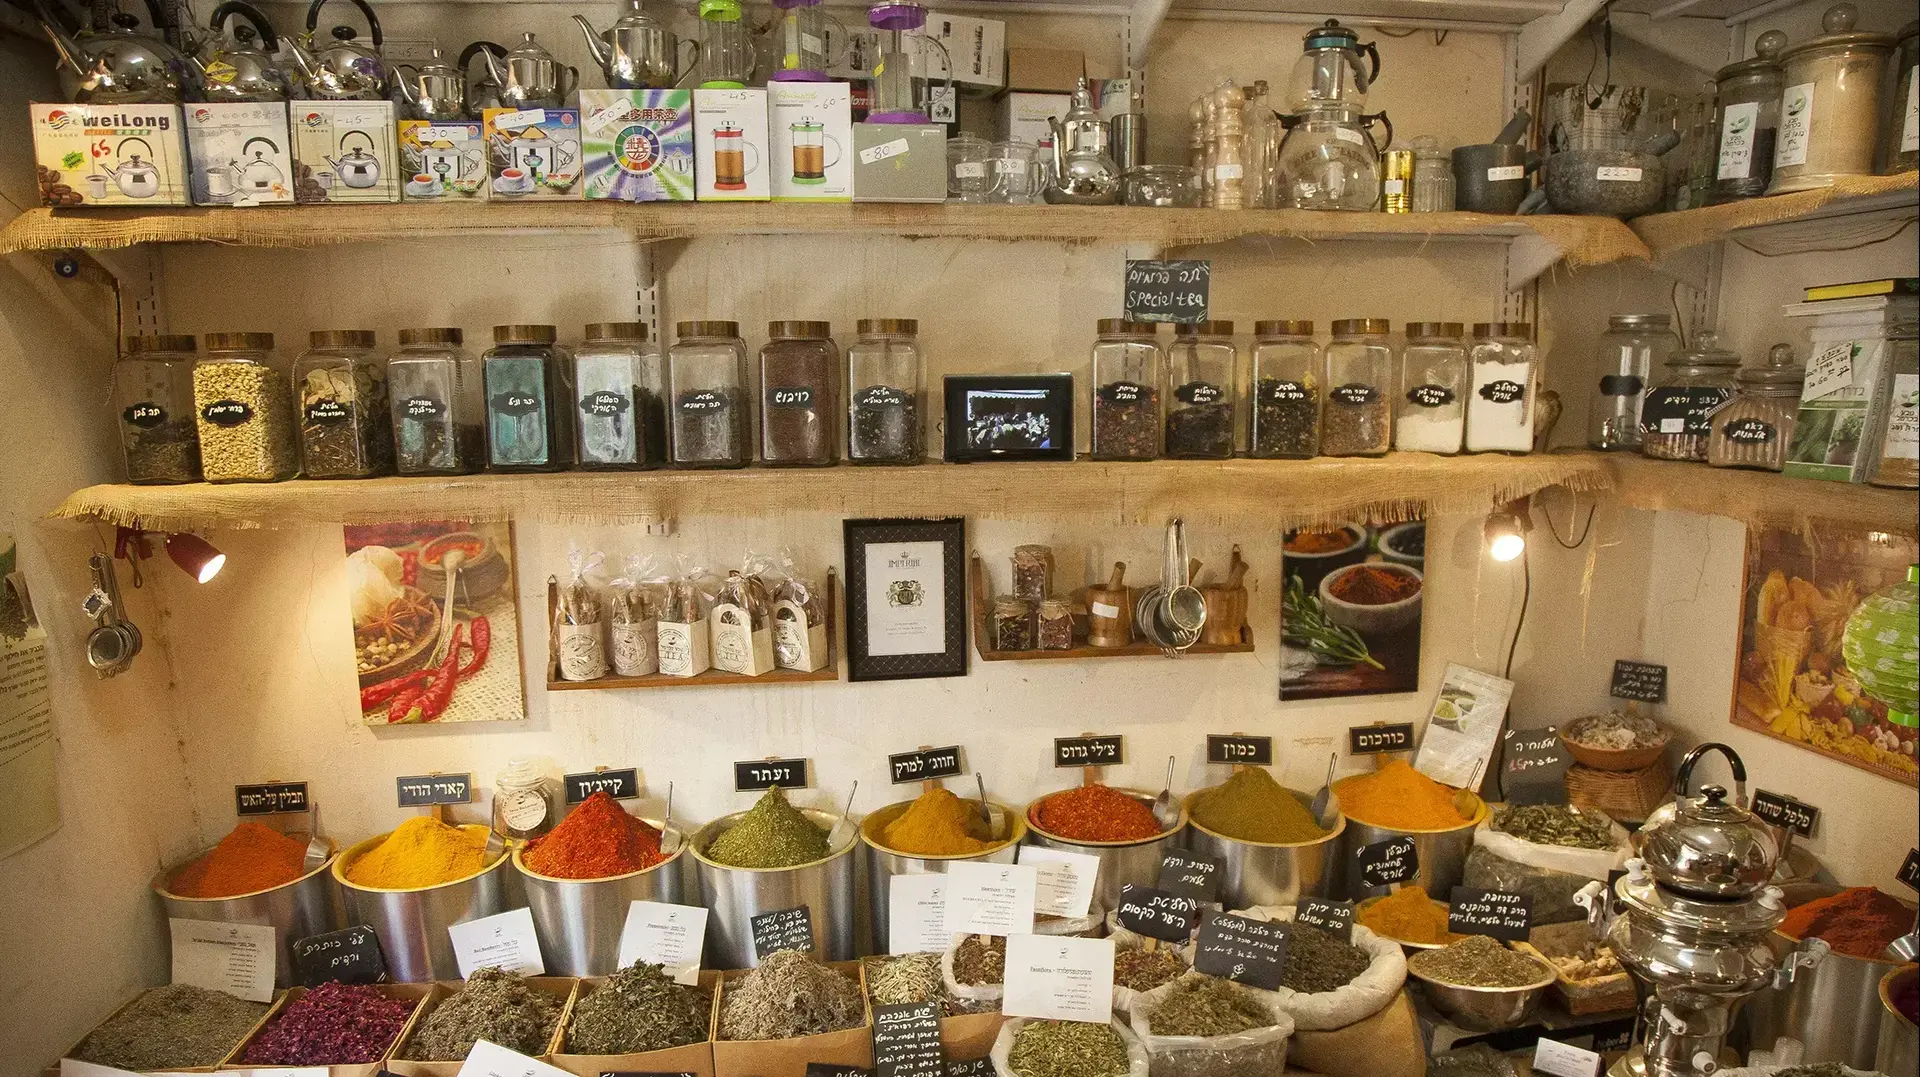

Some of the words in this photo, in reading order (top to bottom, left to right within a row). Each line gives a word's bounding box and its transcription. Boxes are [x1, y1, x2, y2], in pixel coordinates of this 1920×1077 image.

[1180, 268, 1200, 283] תה
[1127, 291, 1174, 308] Special
[1176, 292, 1205, 307] tea
[1359, 732, 1404, 746] כורכום
[1062, 746, 1088, 758] גרוס
[1224, 742, 1256, 759] כמון
[752, 768, 790, 781] זעתר
[896, 757, 924, 778] למרק
[403, 783, 431, 796] הודי
[435, 781, 466, 798] קארי
[279, 788, 304, 808] תבלין
[1757, 799, 1782, 817] שחור
[1784, 804, 1810, 828] פלפל
[1385, 844, 1410, 859] תבלין
[1148, 896, 1189, 912] חליטת
[1480, 893, 1520, 903] תערובת
[780, 910, 802, 921] שיבה
[1120, 903, 1155, 920] הקסום
[1333, 906, 1350, 917] תה
[1161, 912, 1186, 928] היער
[349, 935, 364, 945] עלי
[304, 941, 341, 956] כותרת
[331, 953, 360, 967] ורדים
[879, 1011, 910, 1022] אברהם
[914, 1007, 930, 1017] שיח
